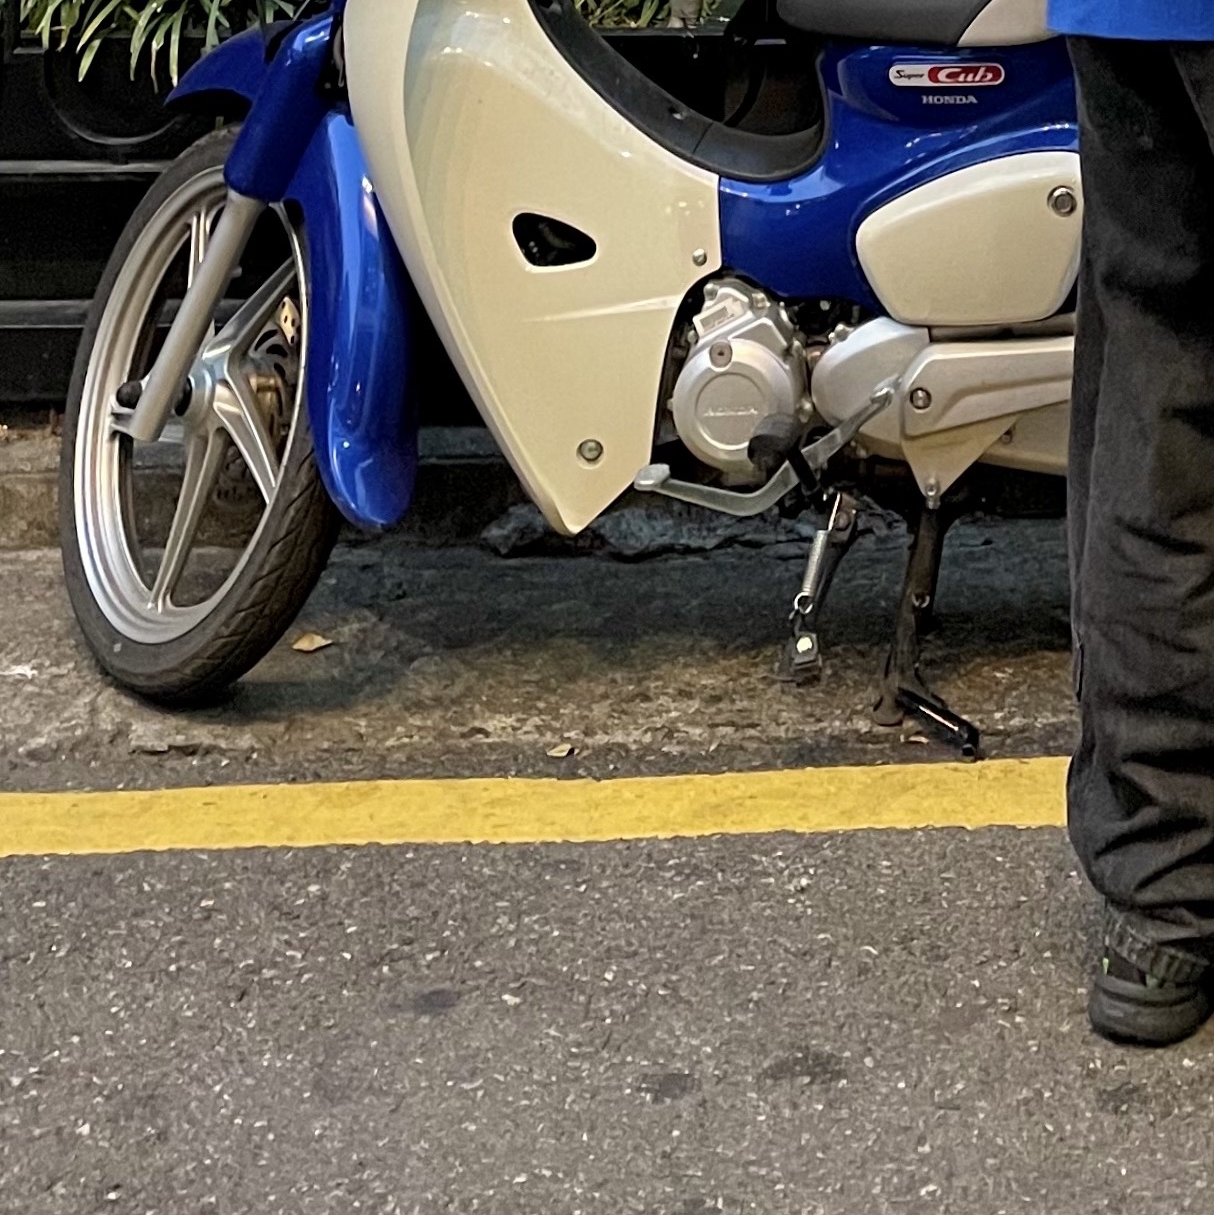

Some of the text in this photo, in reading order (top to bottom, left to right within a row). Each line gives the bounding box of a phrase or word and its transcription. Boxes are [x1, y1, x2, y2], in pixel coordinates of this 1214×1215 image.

[894, 67, 993, 83] Super Cub
[922, 95, 978, 104] HONDA
